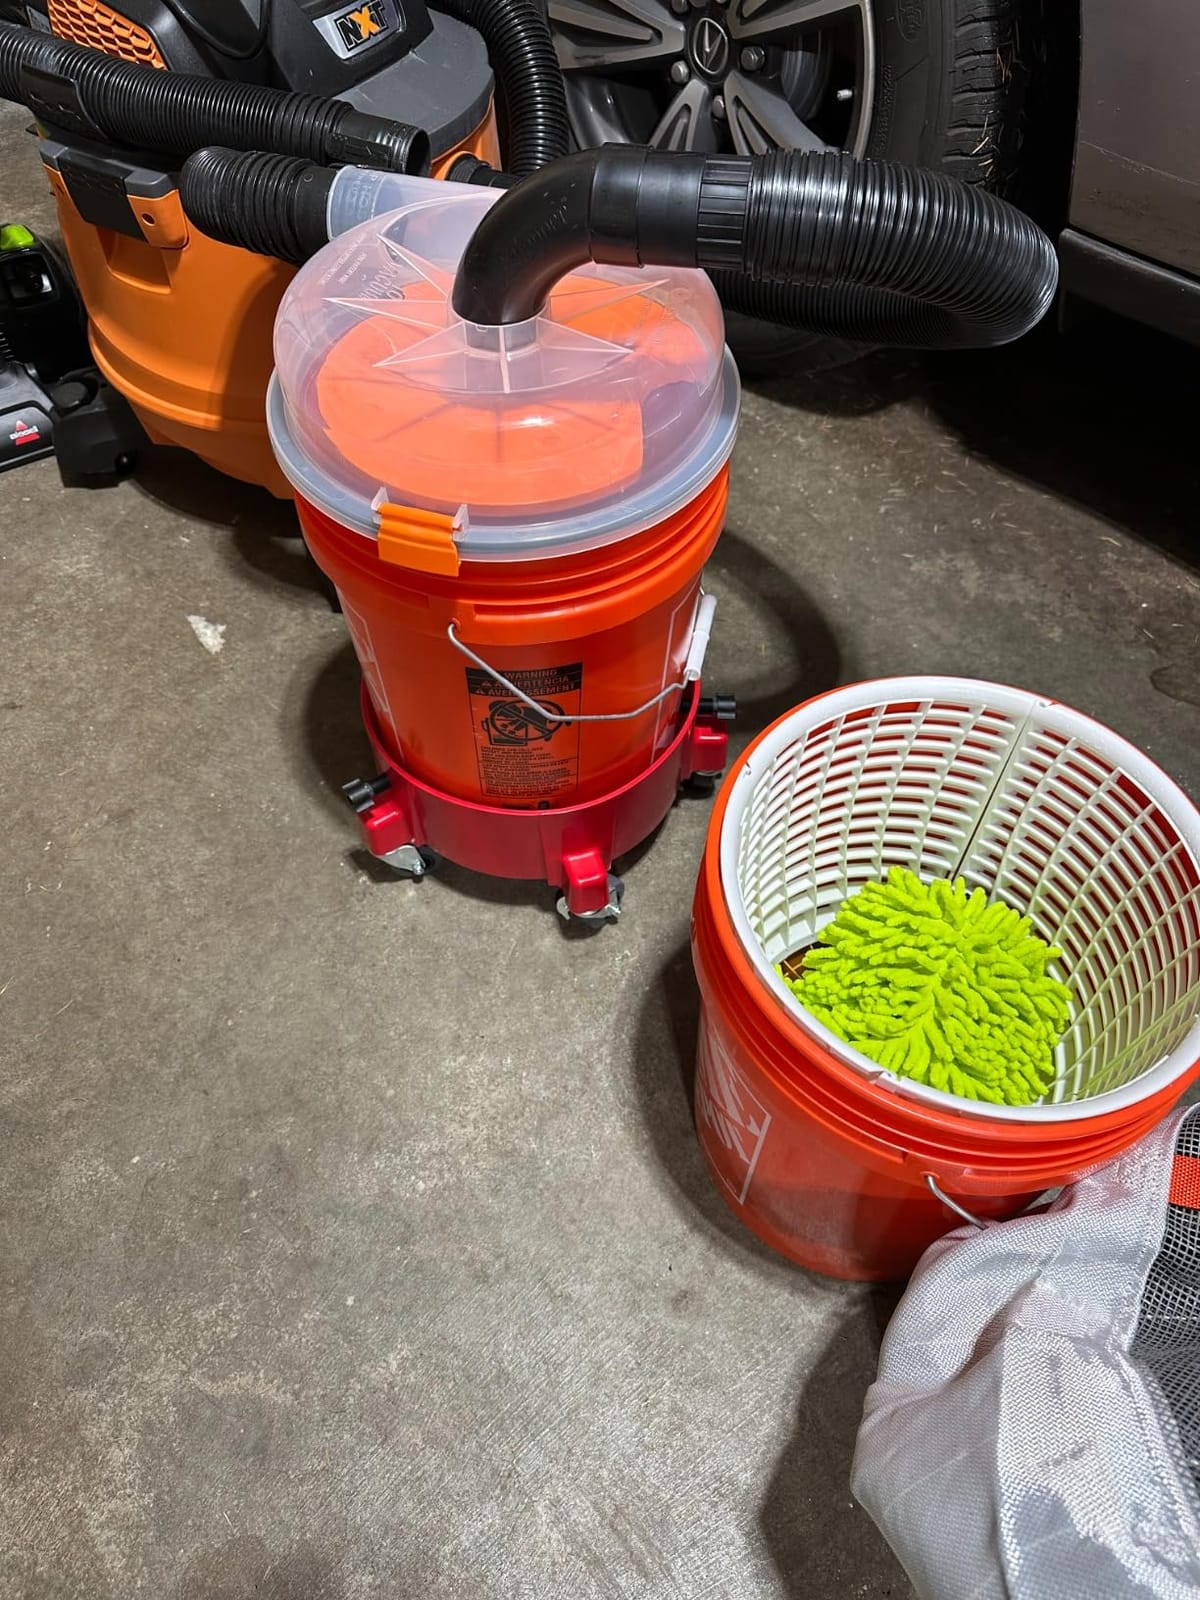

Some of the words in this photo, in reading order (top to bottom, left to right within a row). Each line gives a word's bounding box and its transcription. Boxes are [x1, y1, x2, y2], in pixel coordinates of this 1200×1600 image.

[334, 0, 388, 51] NXT
[503, 669, 558, 680] WARNING
[496, 675, 570, 690] AERTENCIA
